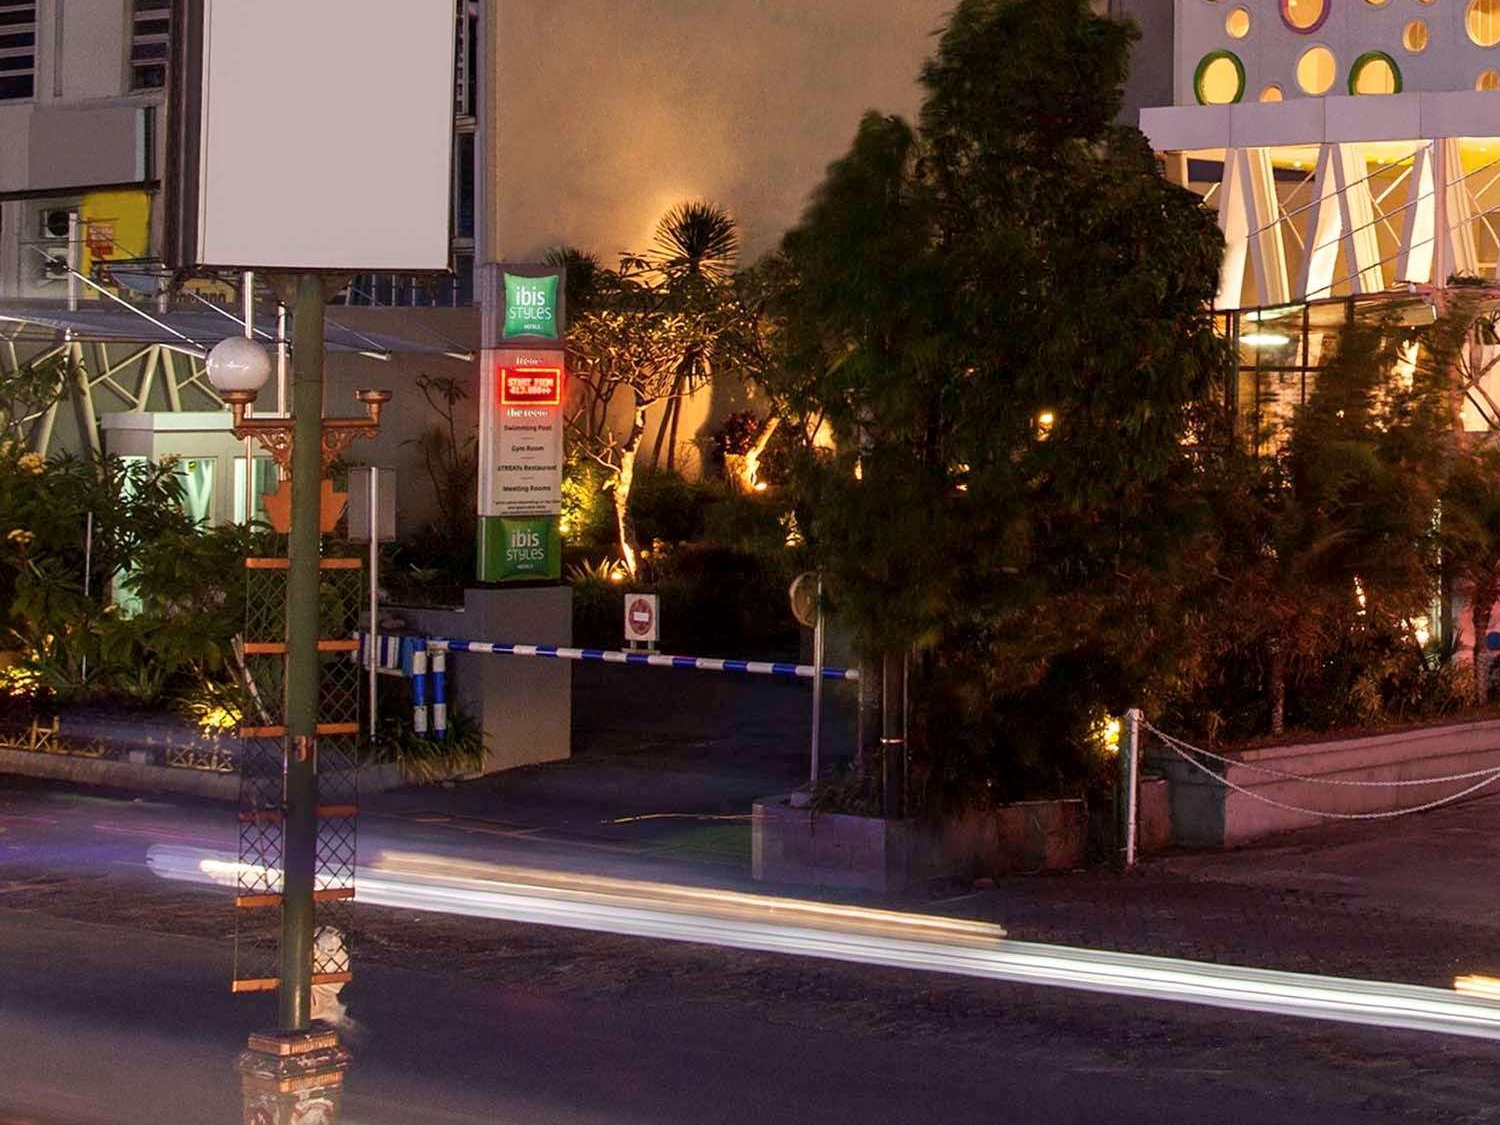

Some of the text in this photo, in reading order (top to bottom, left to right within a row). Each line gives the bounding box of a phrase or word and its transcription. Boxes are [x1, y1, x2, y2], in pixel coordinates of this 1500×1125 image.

[516, 286, 546, 306] ibis
[503, 425, 537, 433] Swimming
[511, 445, 526, 453] Gym
[502, 484, 551, 493] Meeting Rooms
[511, 528, 540, 548] ibis
